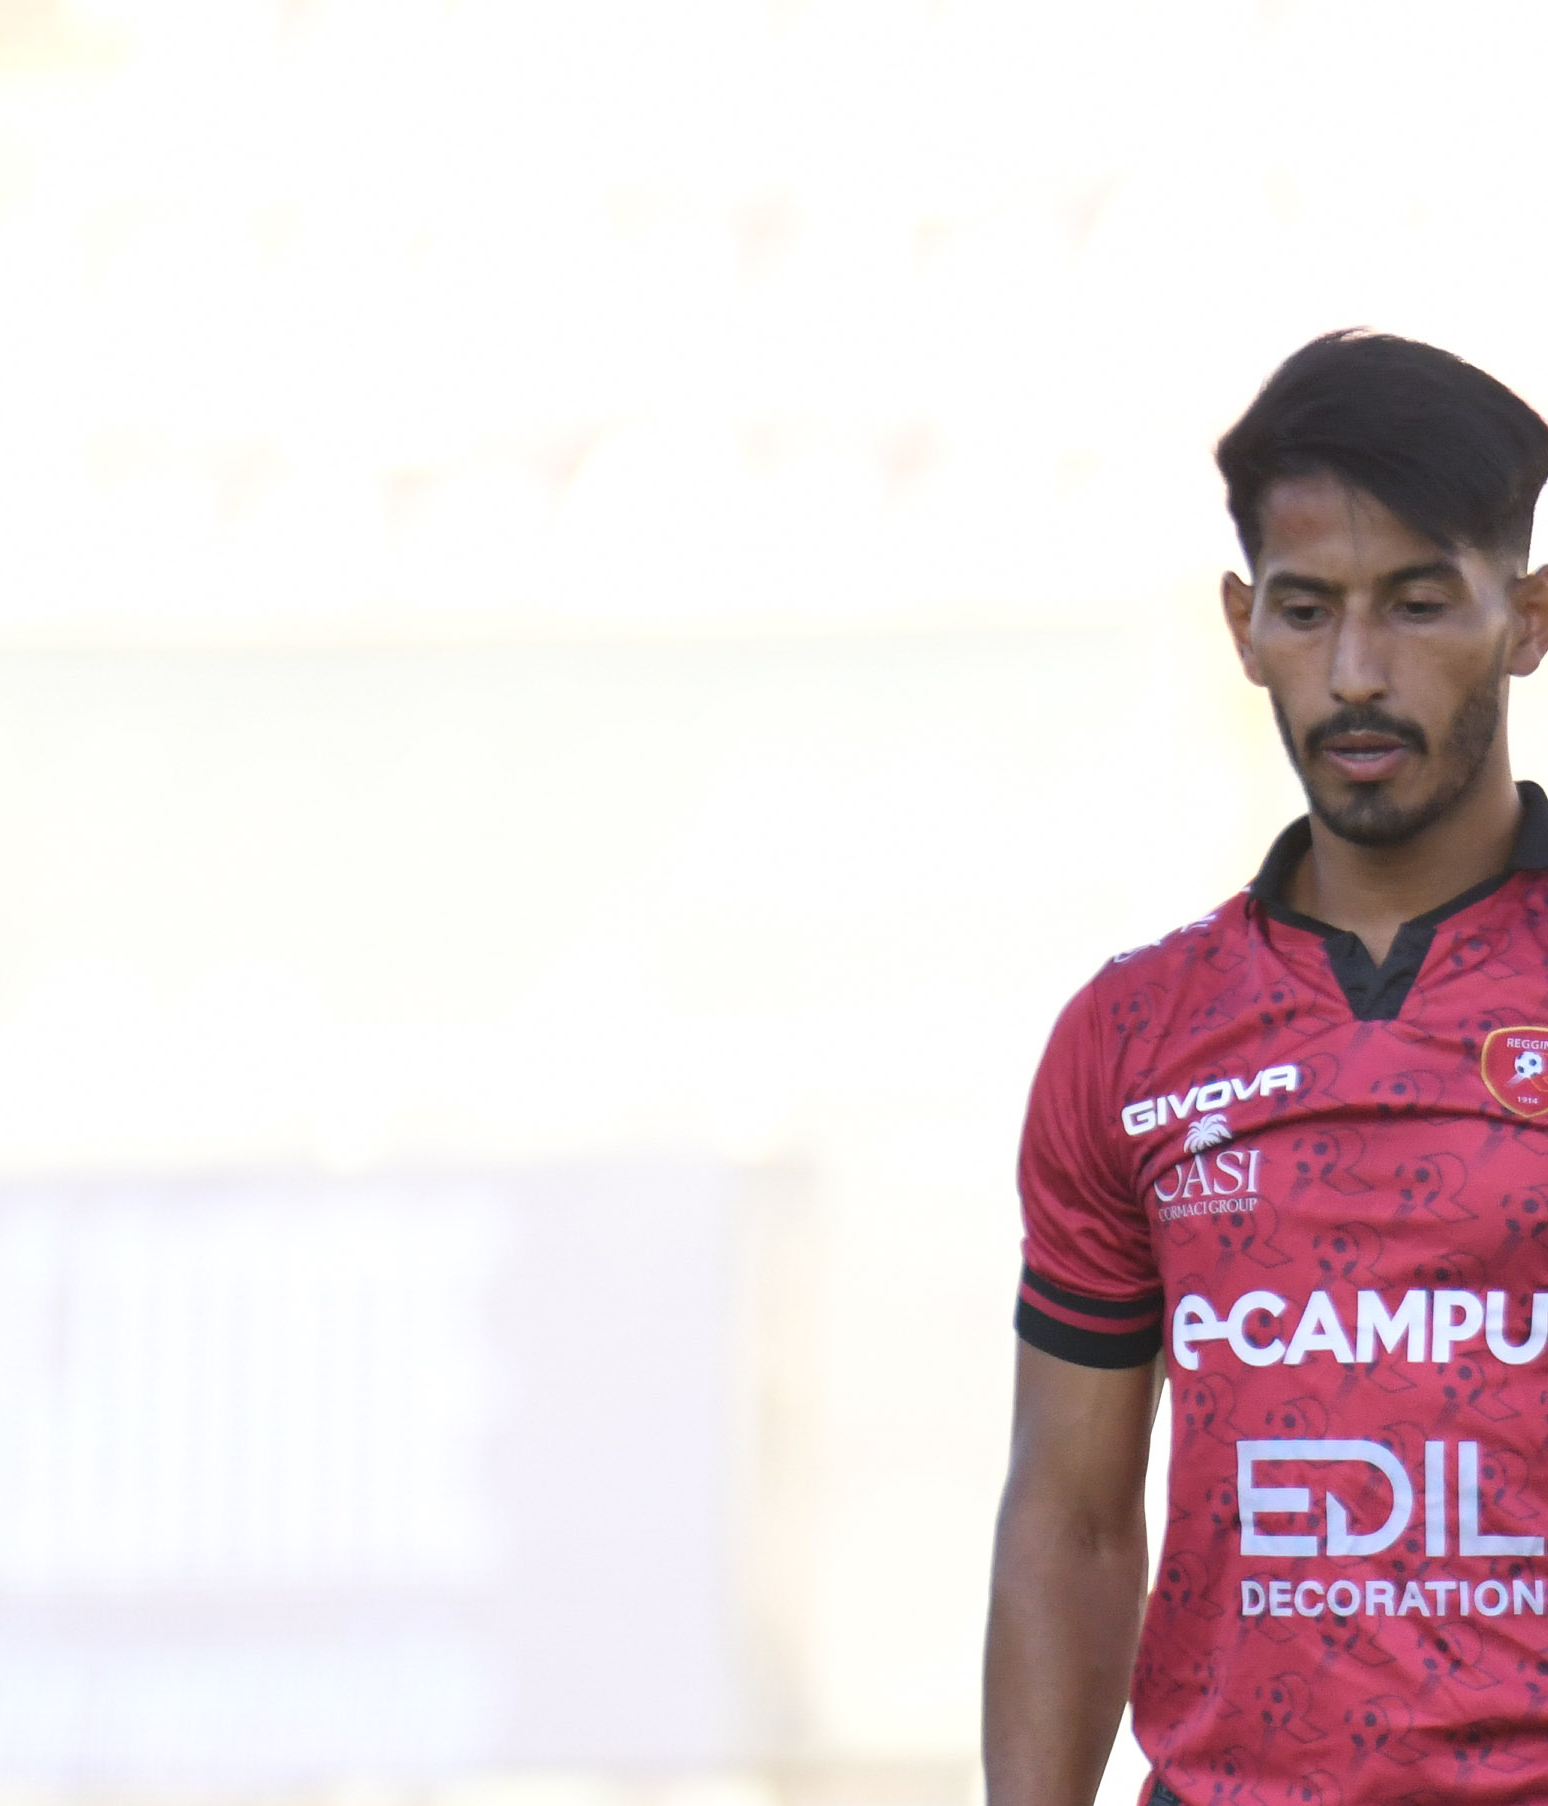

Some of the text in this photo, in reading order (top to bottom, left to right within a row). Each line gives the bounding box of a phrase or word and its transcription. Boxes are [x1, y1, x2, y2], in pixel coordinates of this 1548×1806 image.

[1121, 1064, 1298, 1136] GIVOVA
[1517, 1096, 1539, 1105] 1914
[1153, 1149, 1260, 1202] OASI
[1208, 1197, 1259, 1214] GROUP
[1236, 1439, 1546, 1557] EDIL
[1240, 1579, 1545, 1618] DECORATION
